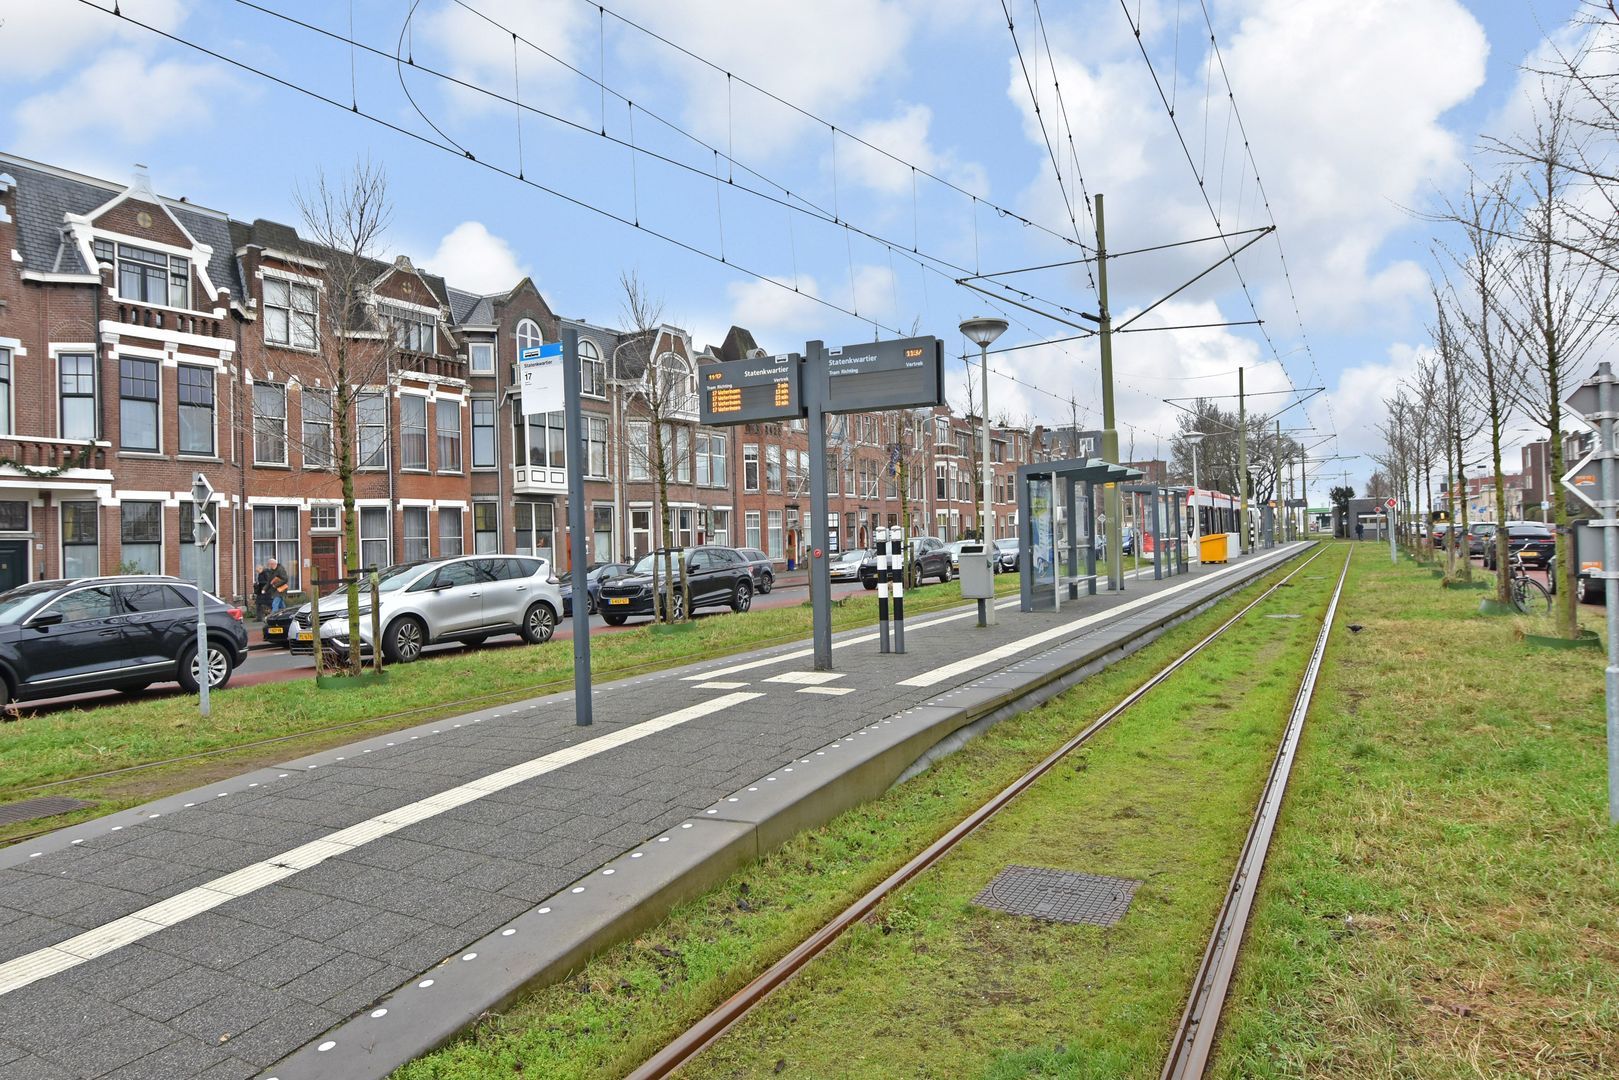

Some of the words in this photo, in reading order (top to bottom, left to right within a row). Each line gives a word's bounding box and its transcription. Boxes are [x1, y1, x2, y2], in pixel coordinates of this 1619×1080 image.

[524, 360, 552, 368] Statenkwartier
[828, 355, 877, 366] Statenkwartier
[744, 366, 789, 377] Statenkwartier
[524, 373, 532, 381] 17
